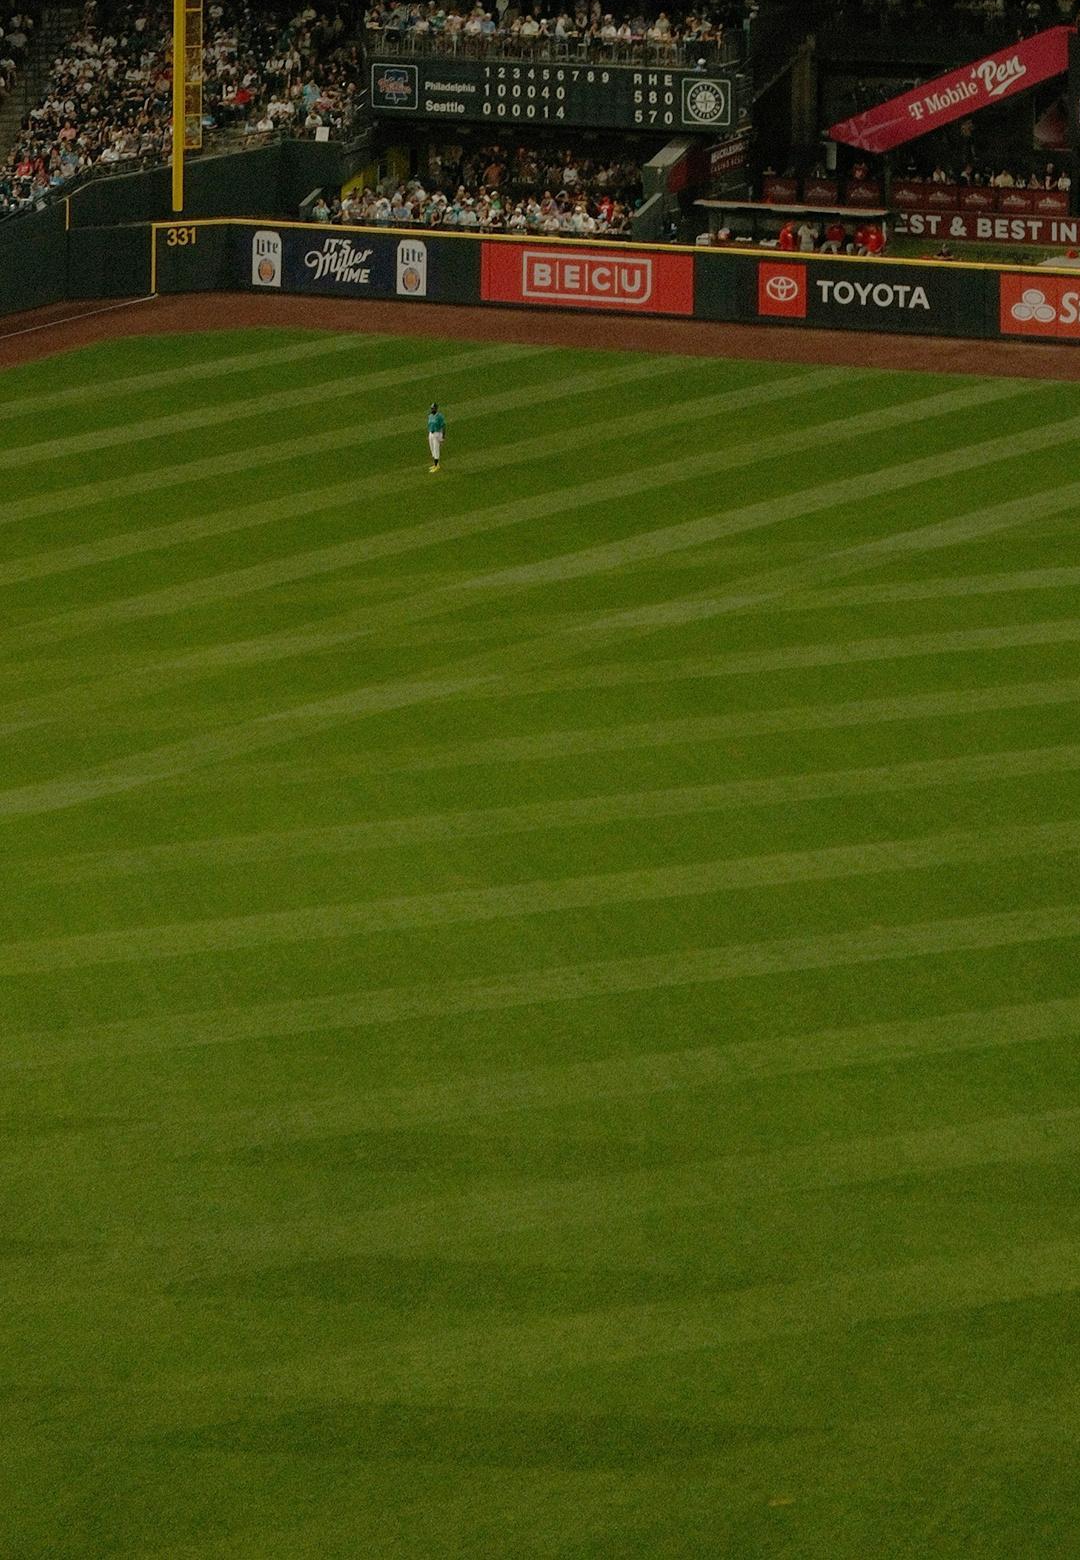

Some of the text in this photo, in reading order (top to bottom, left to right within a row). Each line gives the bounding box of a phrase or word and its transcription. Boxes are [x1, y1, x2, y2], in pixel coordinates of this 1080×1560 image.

[484, 66, 673, 87] 1 2 3 4 5 6 7 8 9 R H E
[424, 81, 476, 94] Philadelphia
[484, 83, 490, 97] 1
[497, 83, 507, 97] 0
[512, 84, 521, 98] 0
[527, 85, 536, 98] 0
[541, 86, 550, 99] 4
[556, 86, 565, 100] 0
[634, 90, 643, 104] 5
[648, 90, 658, 104] 8
[664, 91, 674, 105] 0
[924, 81, 979, 114] Mobile
[425, 99, 673, 125] Seattle 0 0 0 0 1 4 5 7 0
[166, 227, 198, 246] 331
[950, 214, 968, 237] &
[976, 217, 1045, 243] BEST
[1051, 221, 1079, 243] IN
[256, 238, 279, 256] Lite
[323, 238, 352, 253] IT'S
[401, 247, 424, 265] Lite
[304, 247, 373, 280] Miller
[335, 268, 371, 284] TIME
[816, 279, 930, 310] TOYOTA
